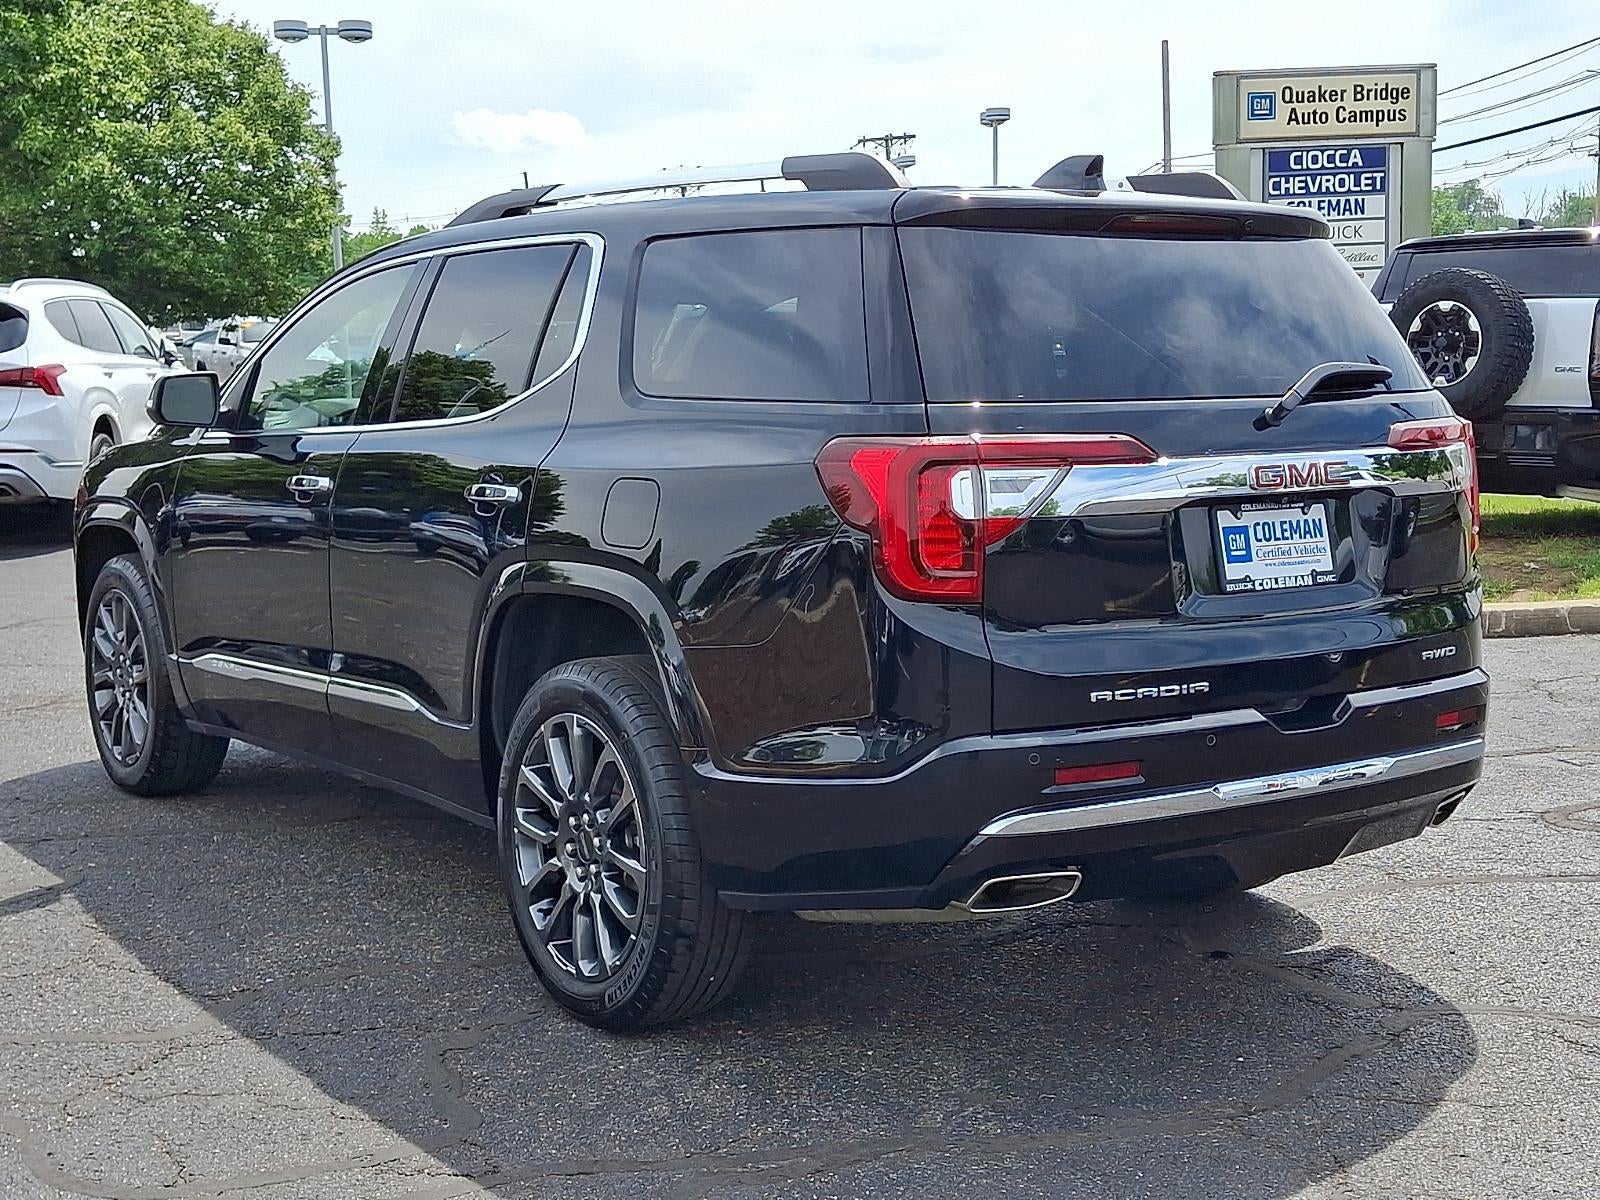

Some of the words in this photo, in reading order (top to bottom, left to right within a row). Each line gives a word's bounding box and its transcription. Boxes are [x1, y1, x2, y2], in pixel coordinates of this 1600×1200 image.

[1253, 98, 1270, 110] GM
[1281, 85, 1347, 104] Quaker
[1353, 83, 1411, 105] Bridge
[1286, 107, 1329, 125] Auto
[1335, 105, 1407, 127] Campus
[1289, 149, 1363, 170] CIOCCA
[1268, 173, 1385, 195] CHEVROLET
[1329, 225, 1363, 239] UICK
[1250, 461, 1350, 489] GMC
[1253, 517, 1324, 543] COLEMAN
[1228, 533, 1246, 550] GM
[1256, 545, 1292, 559] Certified
[1293, 543, 1327, 557] Vehicles
[1226, 581, 1255, 591] BUICK
[1255, 574, 1314, 591] COLEMAN
[1316, 574, 1337, 583] GMC
[1422, 646, 1457, 660] AWD
[1090, 681, 1210, 703] ACADIA
